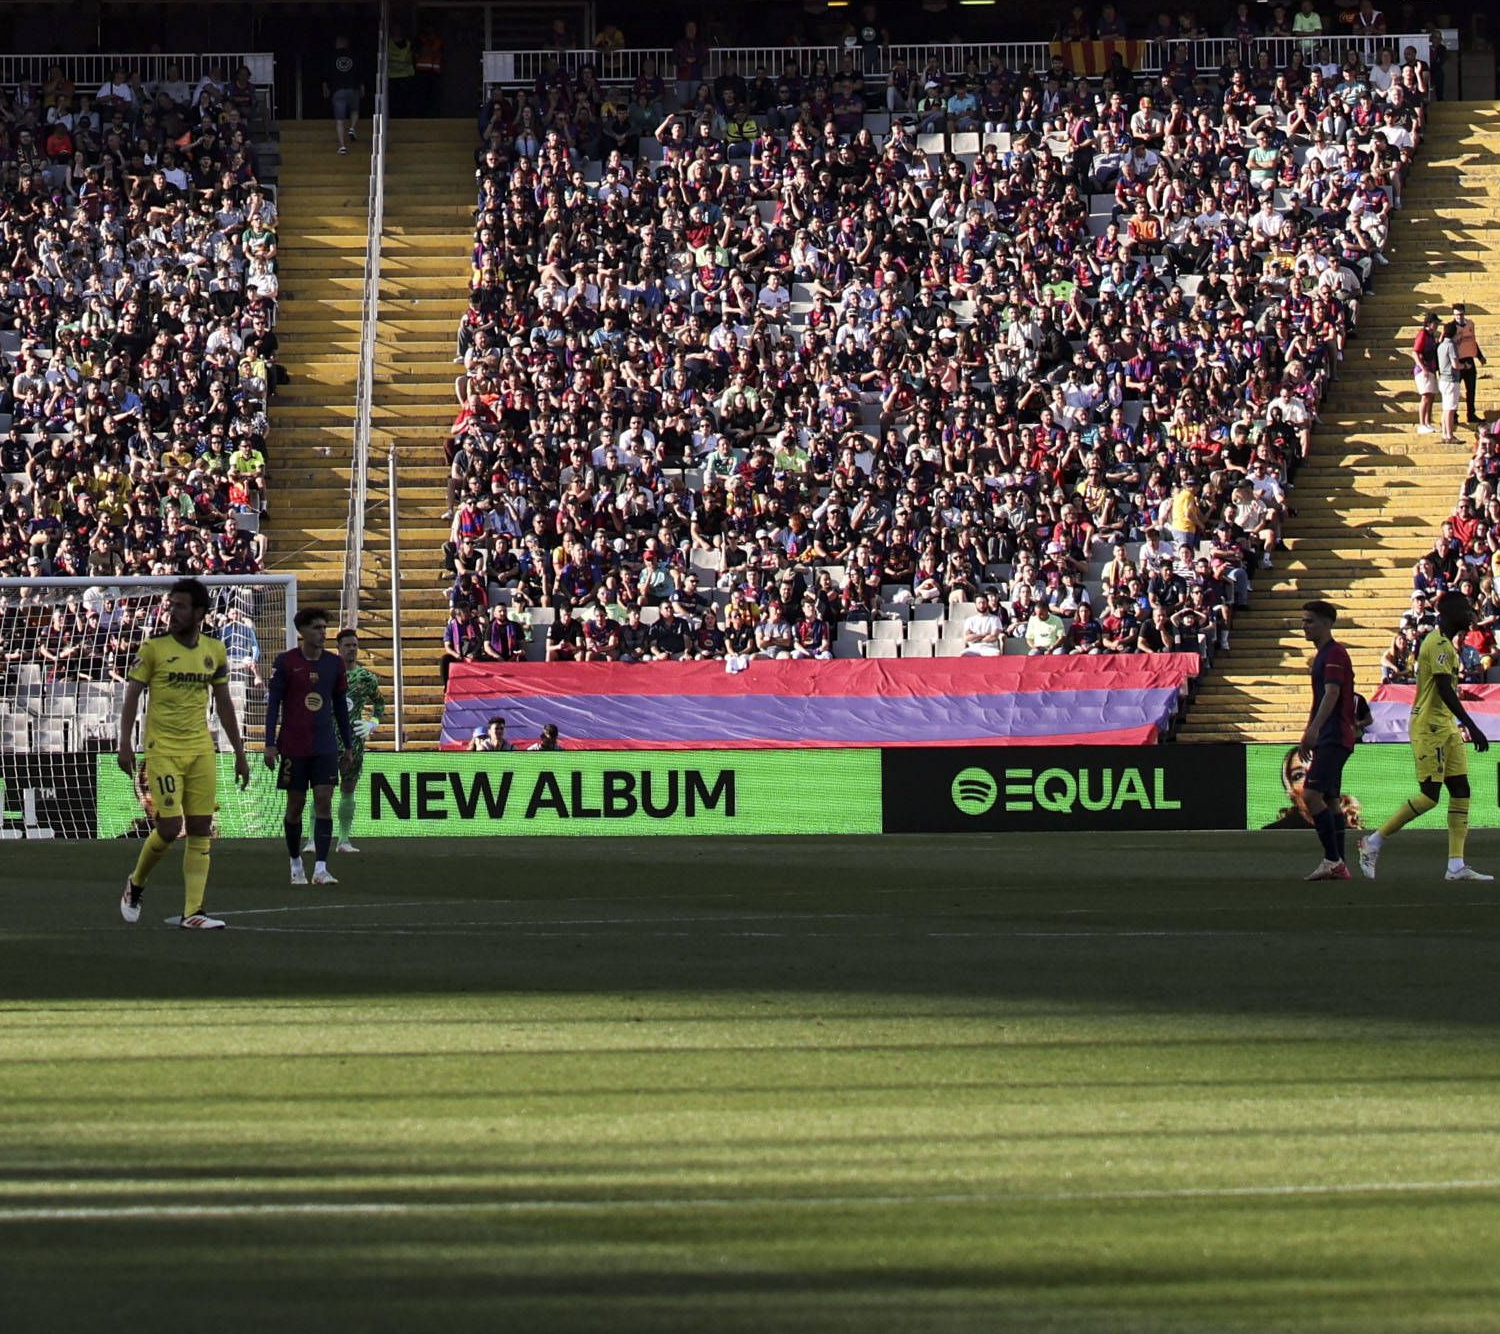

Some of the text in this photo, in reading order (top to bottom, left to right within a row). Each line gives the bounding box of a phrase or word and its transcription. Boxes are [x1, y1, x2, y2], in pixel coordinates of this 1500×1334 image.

[157, 774, 176, 795] 10
[370, 769, 736, 820] NEW ALBUM
[1005, 768, 1181, 813] EQUAL
